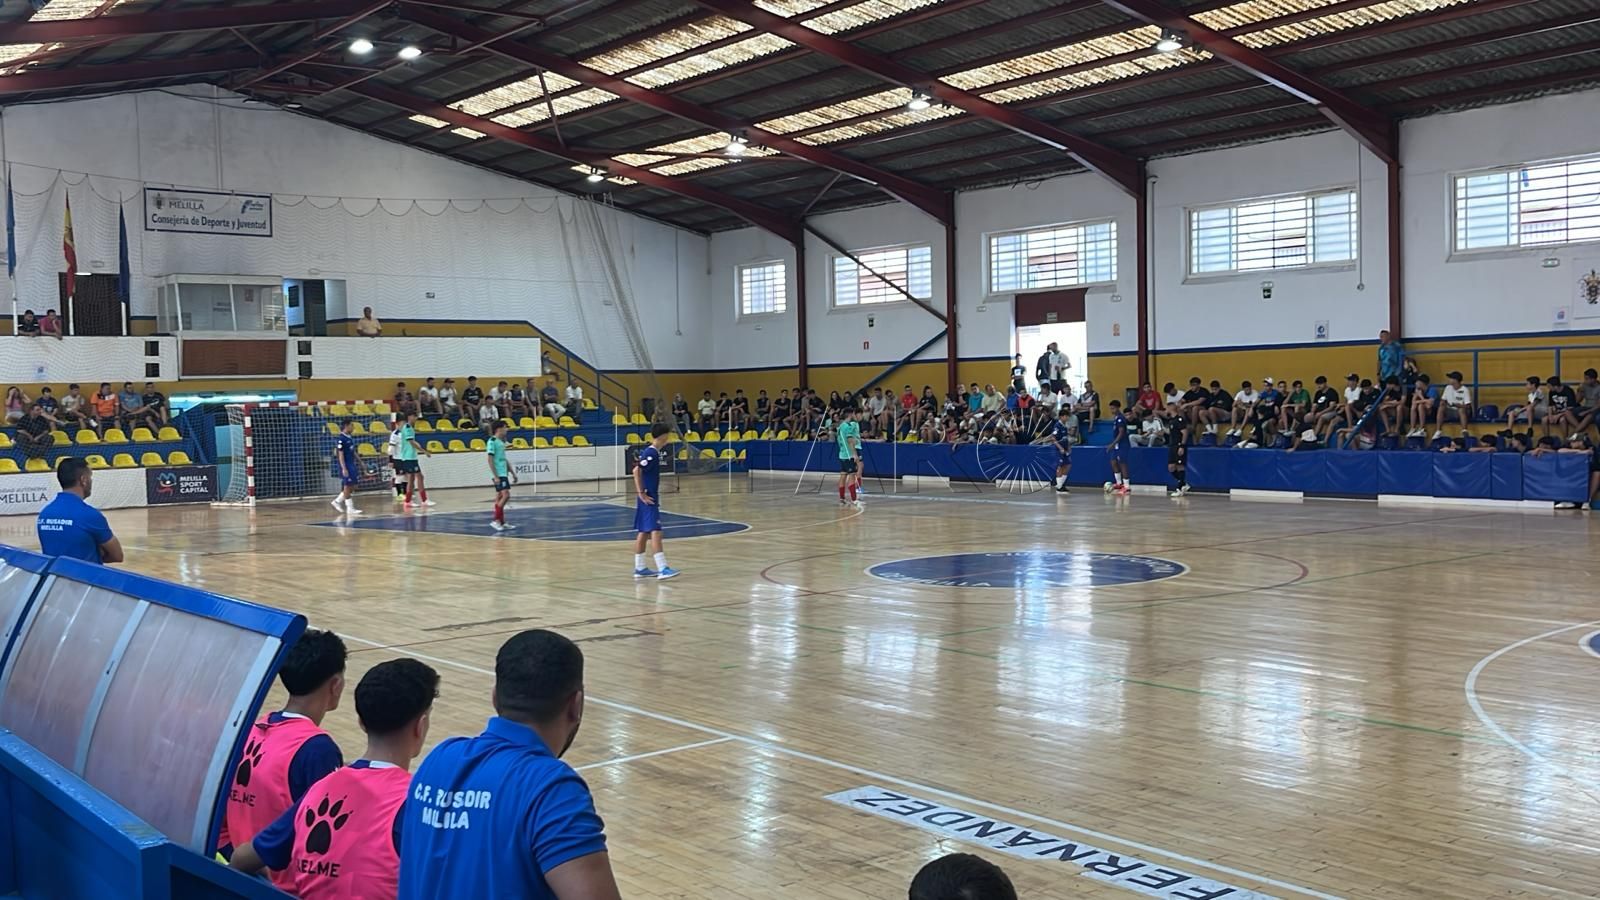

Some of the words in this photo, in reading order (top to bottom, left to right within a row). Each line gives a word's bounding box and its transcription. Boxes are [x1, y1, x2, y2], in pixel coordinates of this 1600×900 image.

[169, 200, 205, 210] MELILLA
[190, 216, 200, 226] de
[201, 216, 230, 229] Deporte
[231, 220, 236, 229] y
[236, 218, 267, 230] Juventud
[515, 464, 551, 474] MELILLA
[414, 782, 433, 803] C.F.
[853, 791, 1237, 900] FERNÁNDEZ
